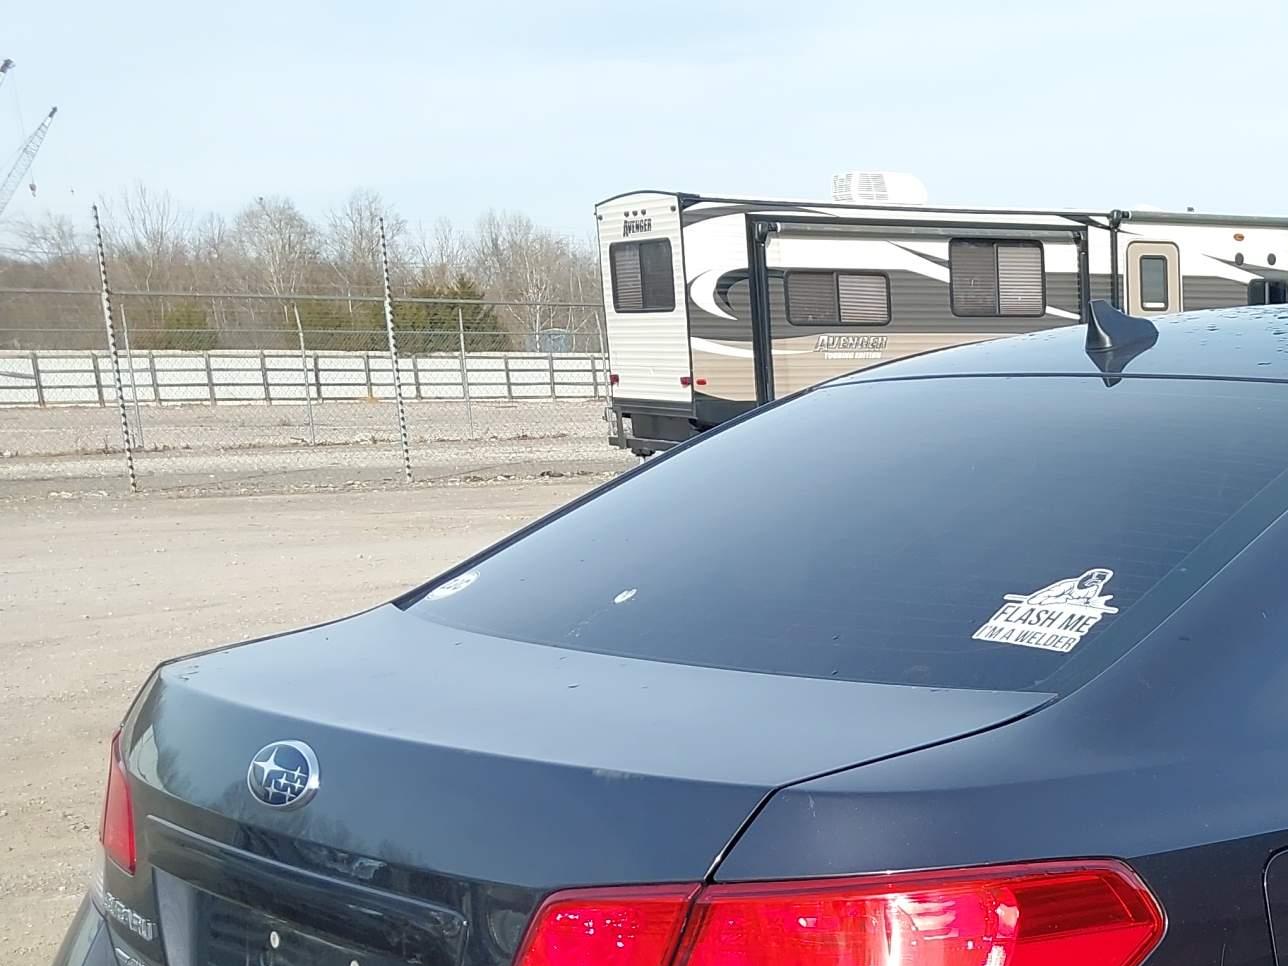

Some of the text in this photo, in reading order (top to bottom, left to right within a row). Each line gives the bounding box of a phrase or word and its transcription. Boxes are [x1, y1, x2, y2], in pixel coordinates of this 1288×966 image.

[623, 219, 652, 237] AVENGER
[814, 335, 888, 352] AVENGER
[993, 605, 1097, 633] FLASH ME
[977, 625, 1077, 650] I'M A WELDER
